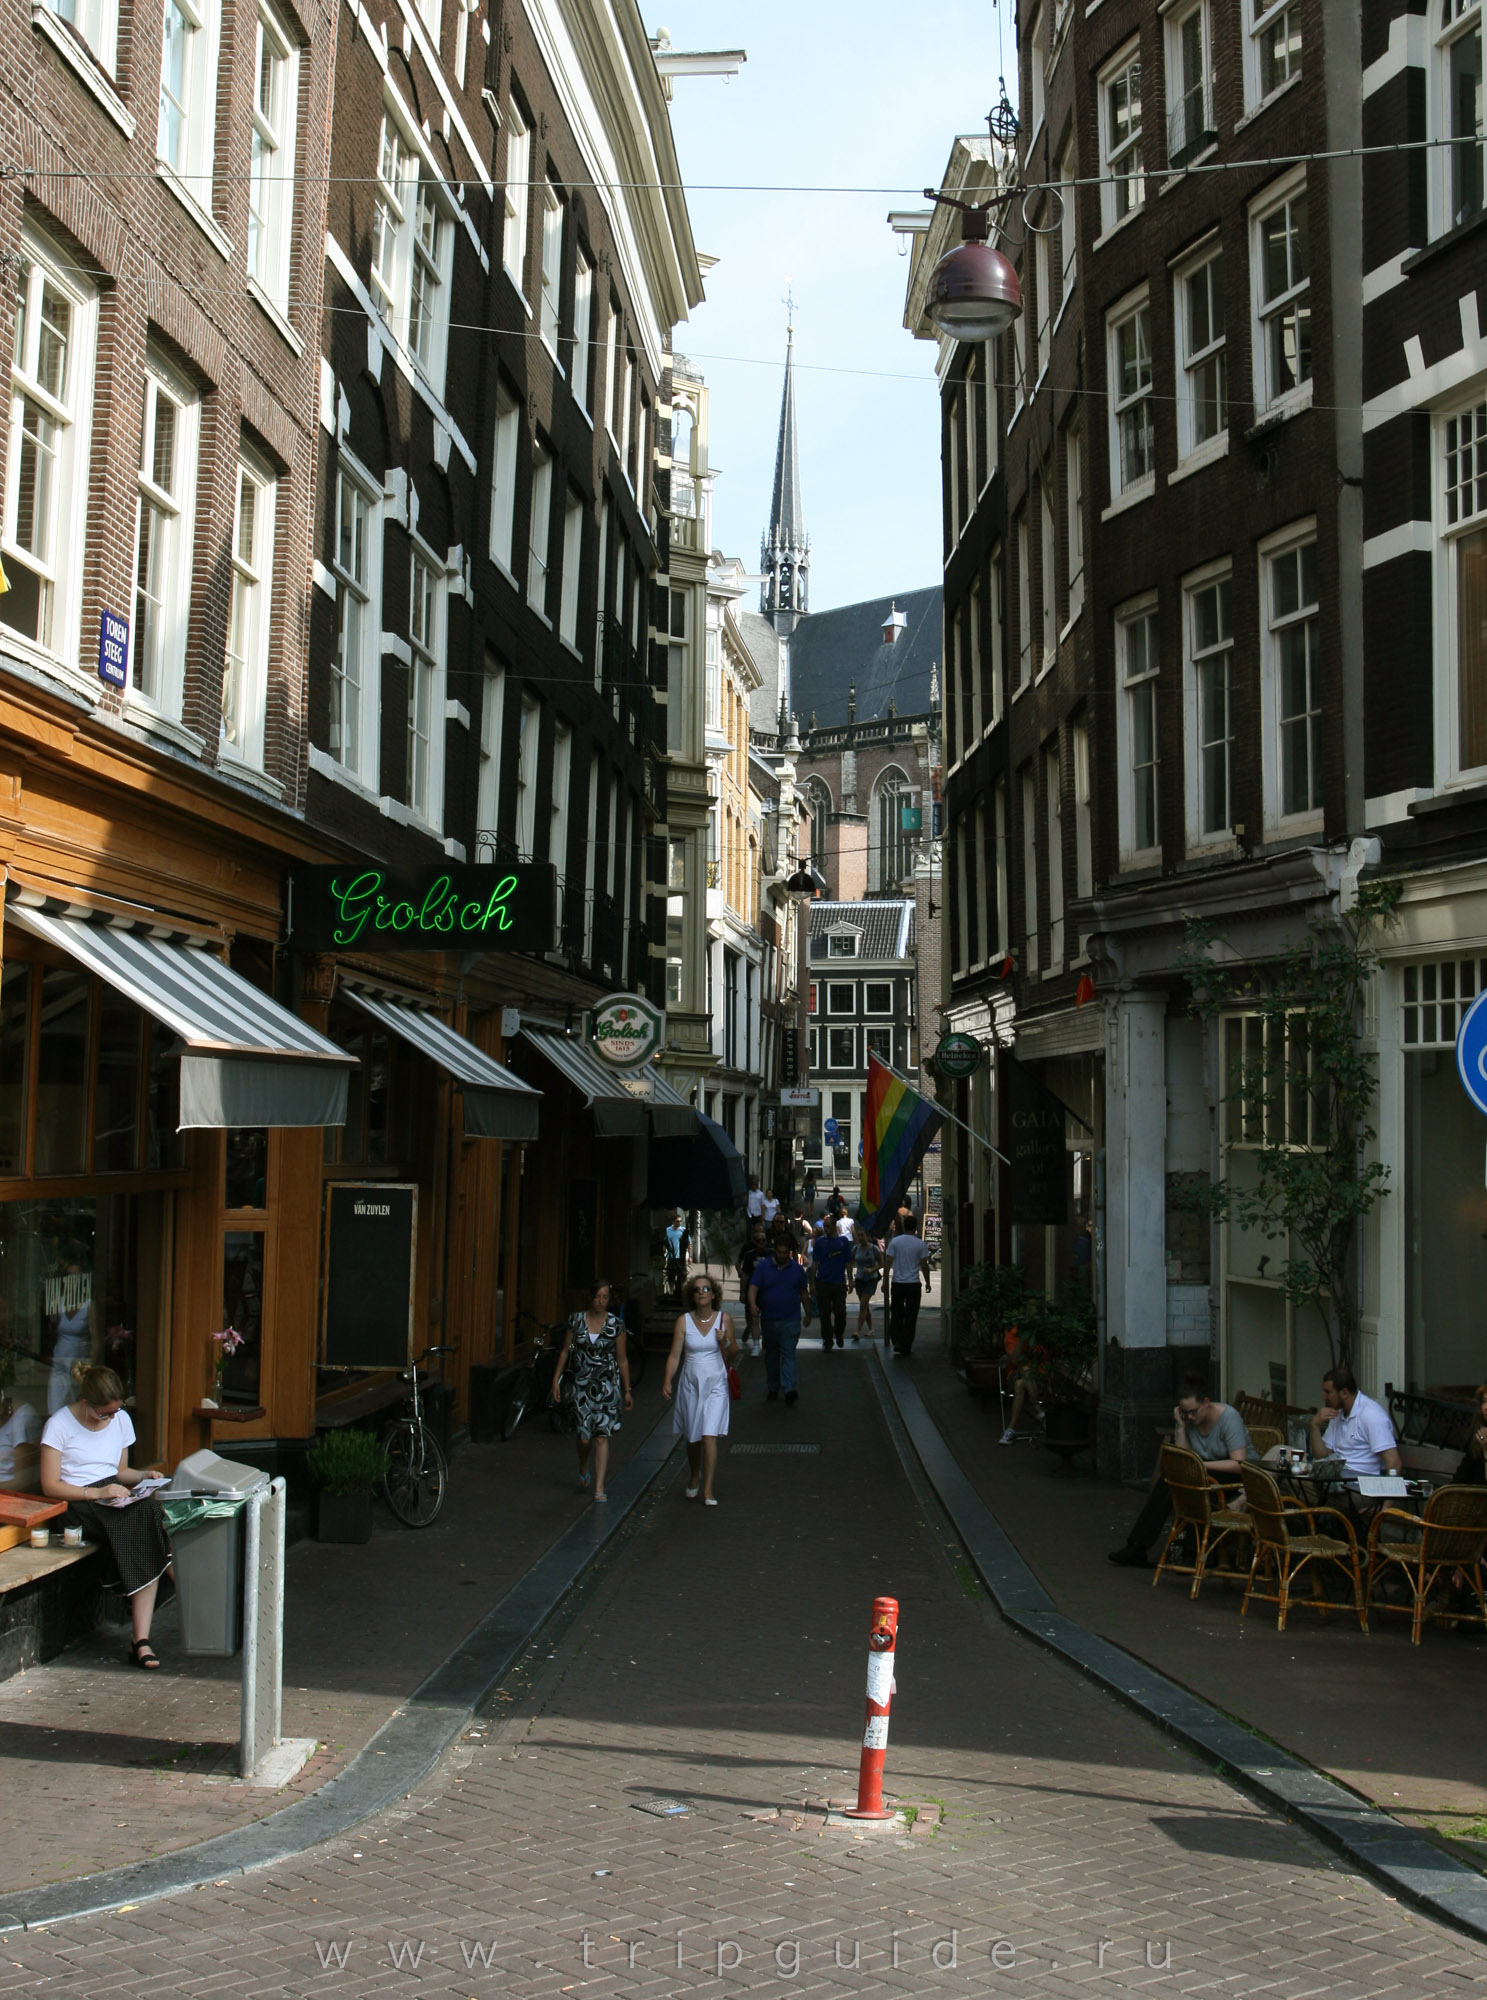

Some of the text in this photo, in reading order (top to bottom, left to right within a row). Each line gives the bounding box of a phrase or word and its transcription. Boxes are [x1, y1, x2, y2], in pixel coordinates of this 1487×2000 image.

[106, 617, 127, 645] TOREN
[104, 639, 123, 664] STEEG
[105, 662, 125, 681] CENTRUM
[330, 871, 520, 945] Grolsch
[597, 1020, 649, 1041] Grolsch
[786, 1030, 795, 1077] KAPPERS
[941, 1051, 977, 1059] Heineken
[1012, 1110, 1062, 1129] GAIA
[353, 1204, 391, 1216] VAN ZUYLEN
[45, 1272, 93, 1317] VAN ZUYLEN
